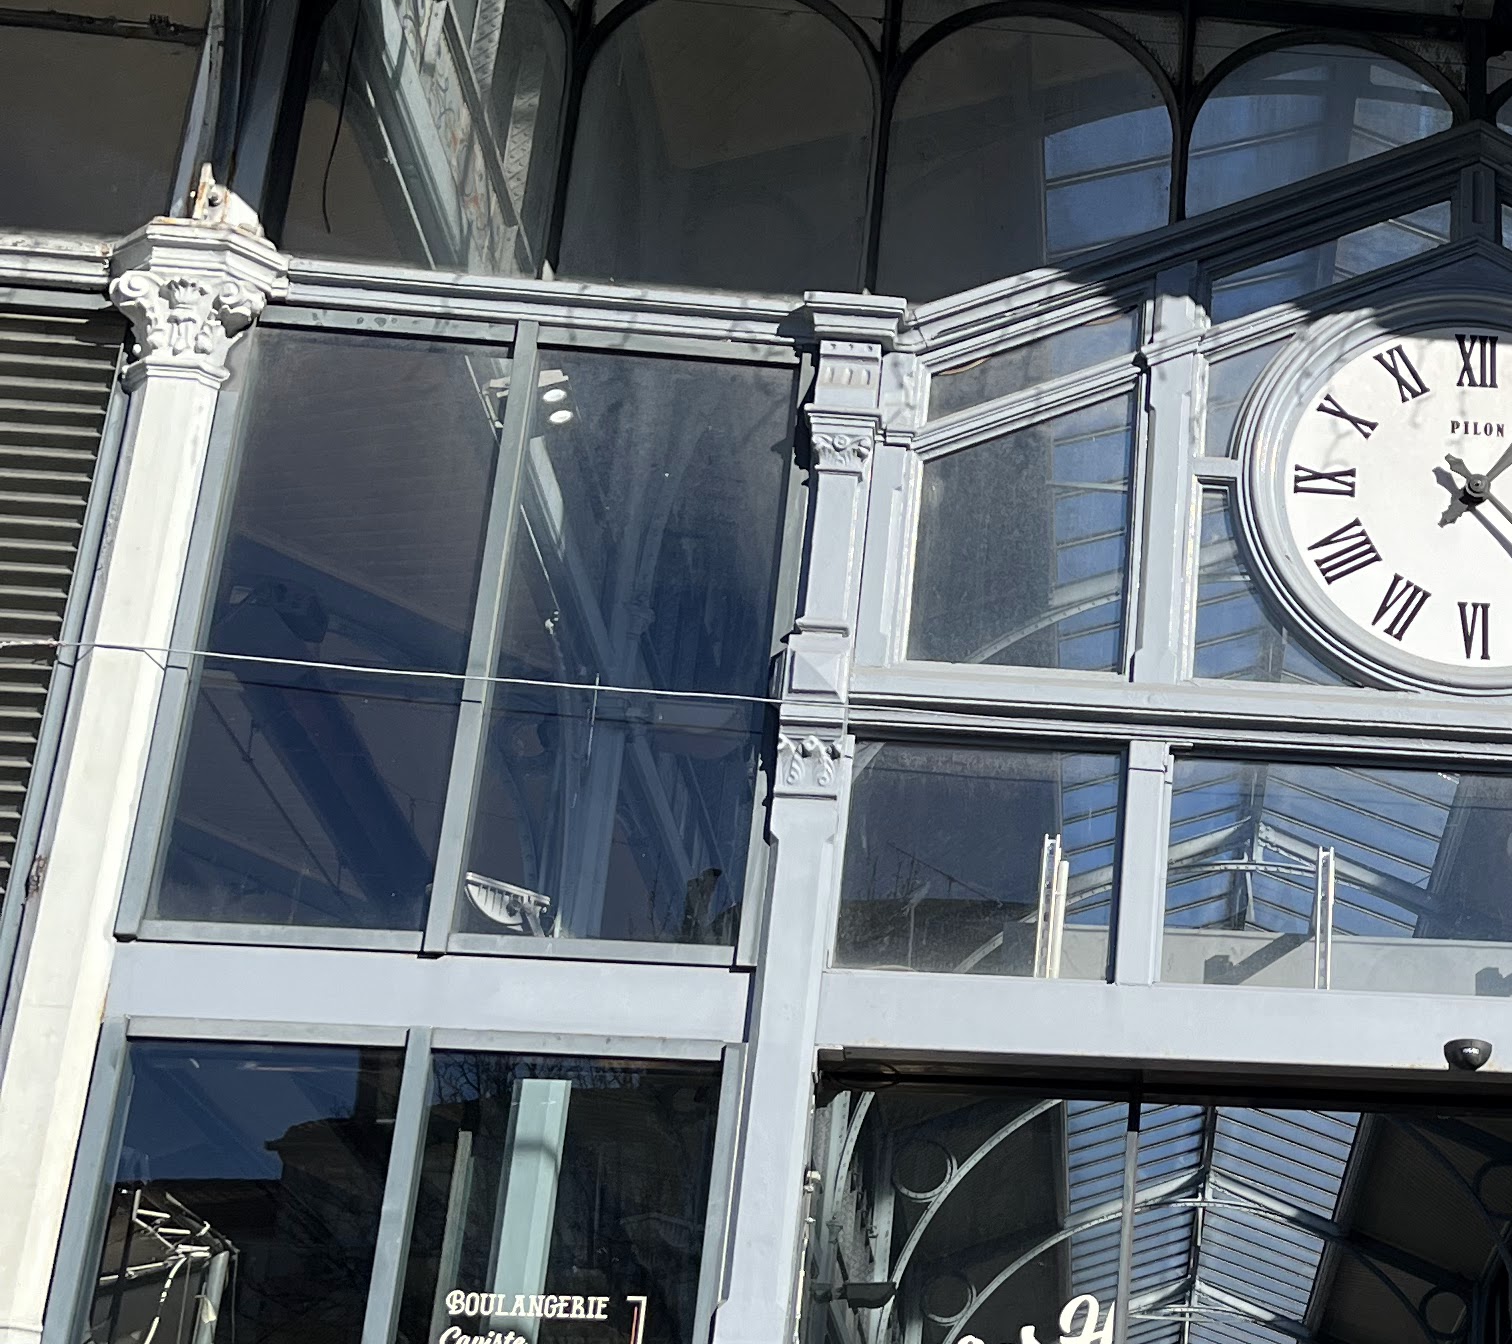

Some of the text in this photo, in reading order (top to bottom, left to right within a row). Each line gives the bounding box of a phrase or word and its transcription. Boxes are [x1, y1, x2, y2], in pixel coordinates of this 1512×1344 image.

[1374, 344, 1430, 402] XI
[1455, 334, 1498, 388] XII
[1316, 394, 1378, 439] X
[1450, 420, 1505, 438] PILON
[1294, 464, 1356, 498] IX
[1307, 518, 1382, 584] VIII
[1371, 573, 1432, 641] VII
[1457, 602, 1490, 660] VI
[446, 1289, 609, 1319] BOULANGERIE
